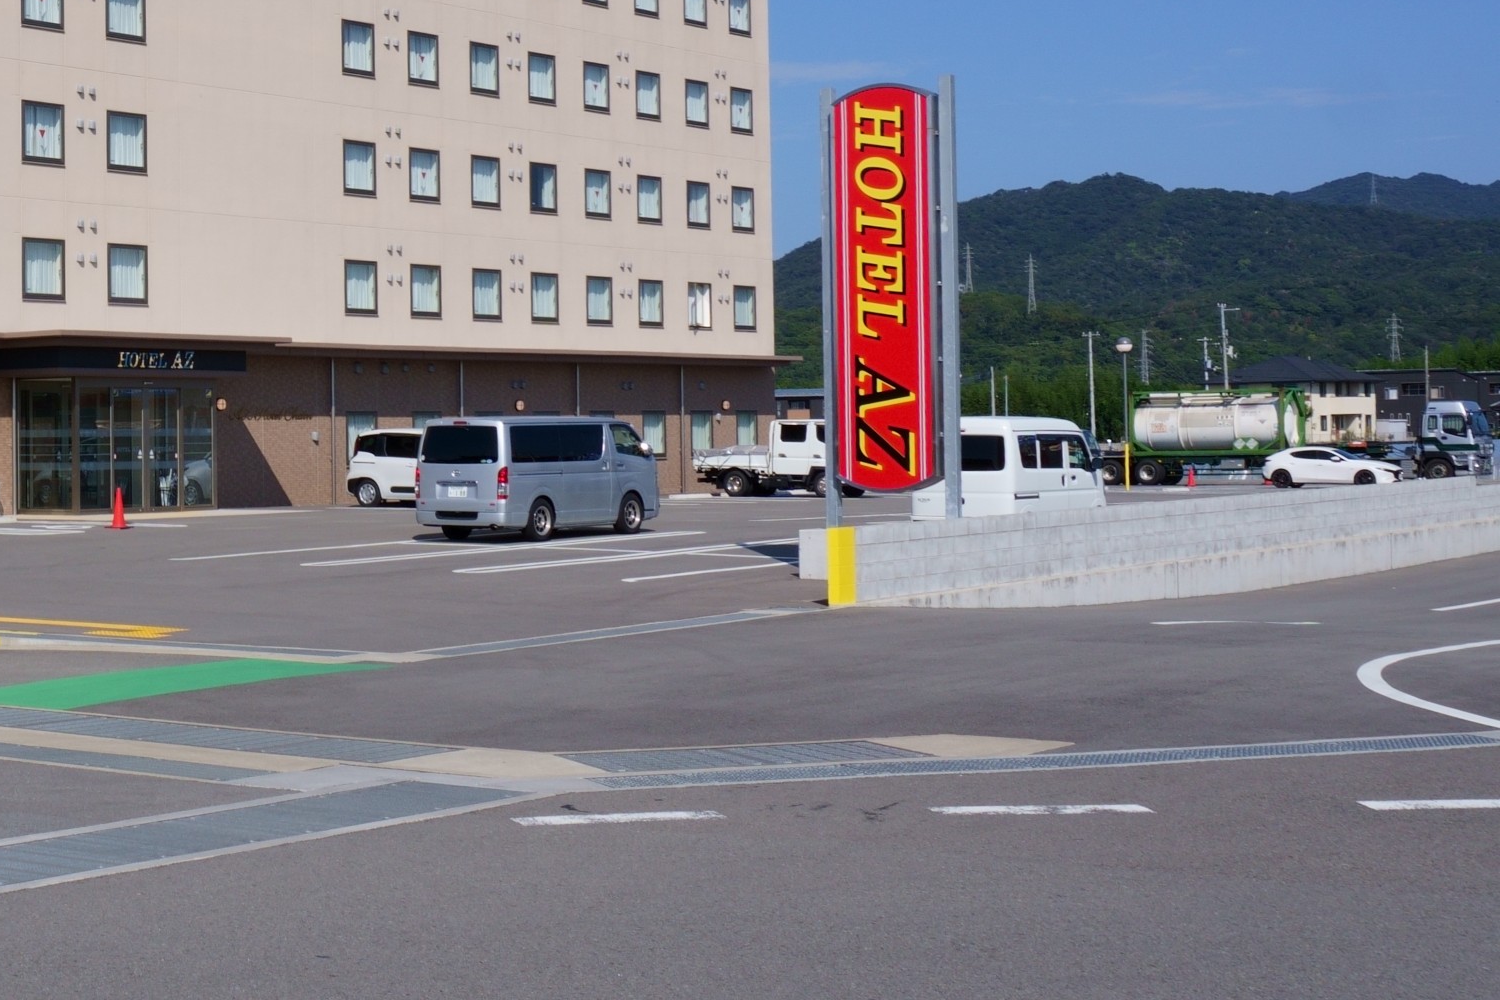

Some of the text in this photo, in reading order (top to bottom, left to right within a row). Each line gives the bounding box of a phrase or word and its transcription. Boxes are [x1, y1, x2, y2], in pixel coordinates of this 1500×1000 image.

[117, 350, 195, 369] HOTEL AZ
[854, 101, 917, 478] HOTEL AZ
